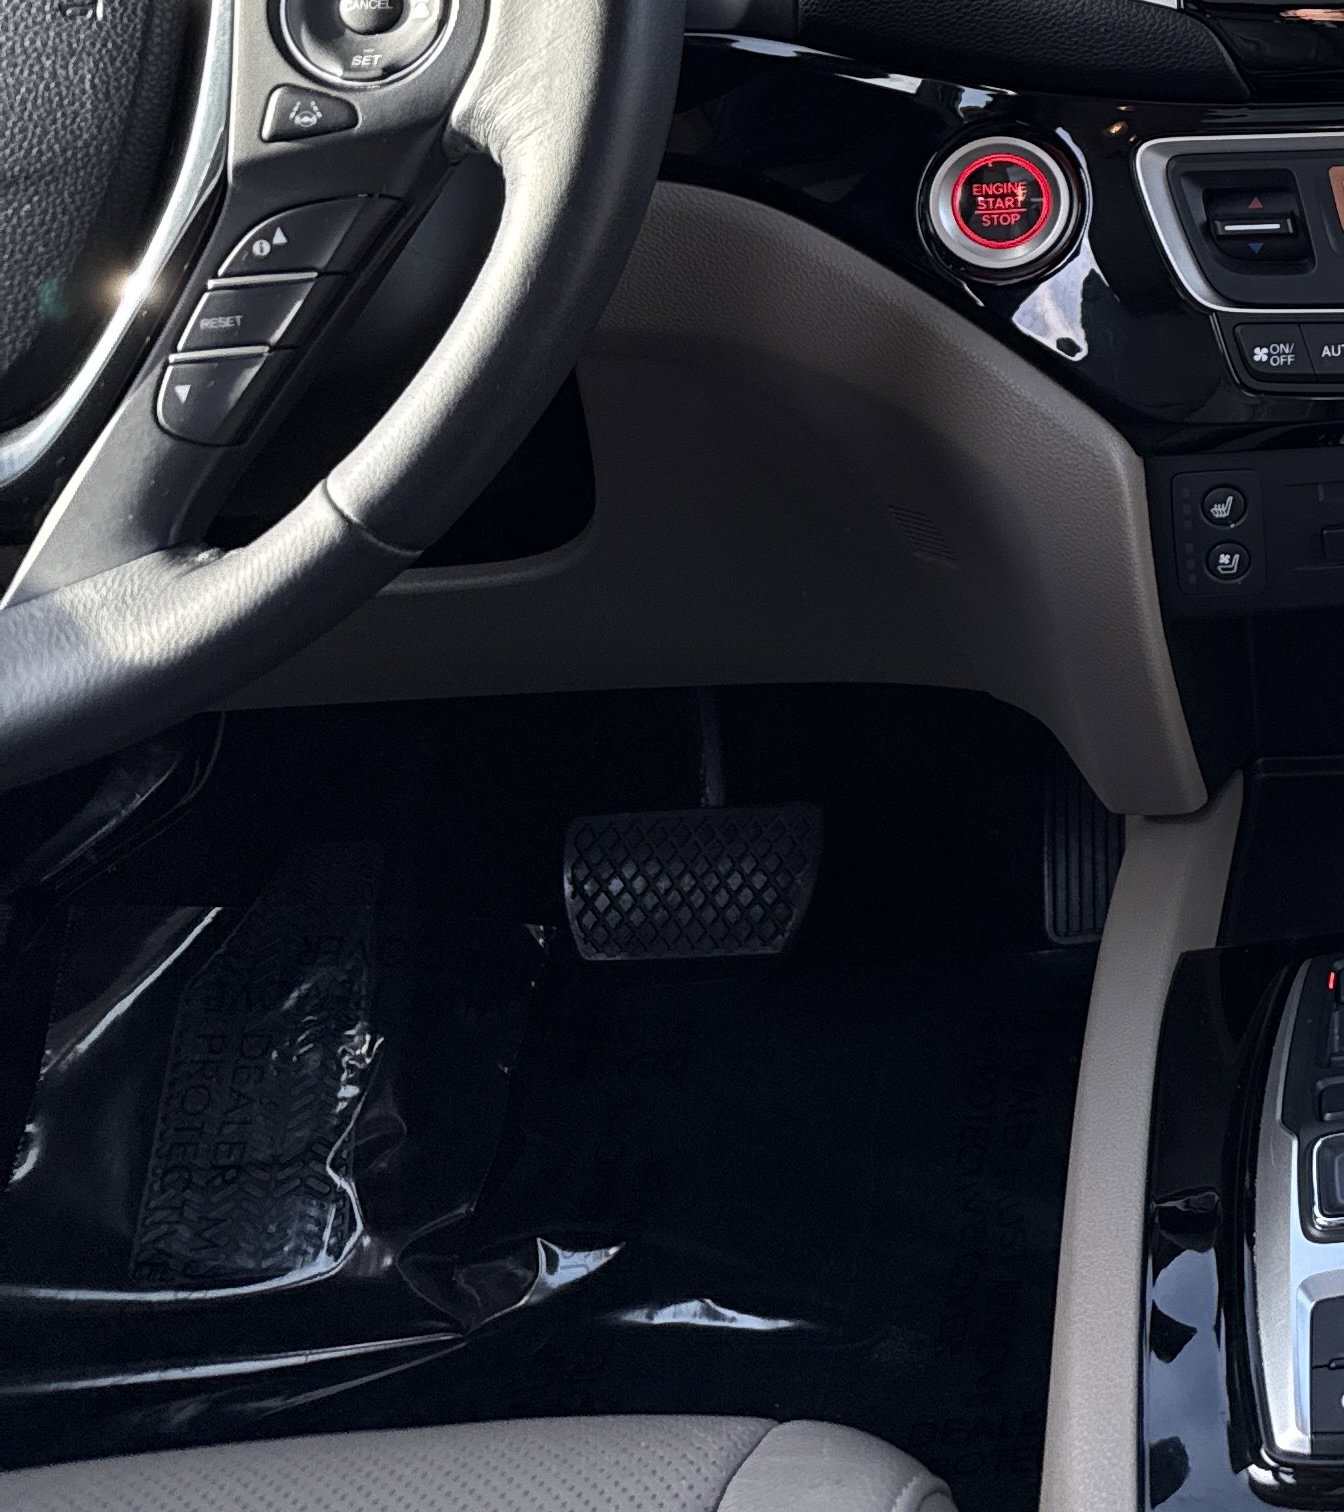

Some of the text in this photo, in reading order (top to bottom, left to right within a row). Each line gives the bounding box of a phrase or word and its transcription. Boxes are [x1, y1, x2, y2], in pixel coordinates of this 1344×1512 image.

[344, 0, 394, 11] CANCEL
[351, 54, 383, 66] SET
[971, 181, 1028, 196] ENGINE
[977, 196, 1022, 210] START
[981, 213, 1021, 227] STOP
[200, 315, 243, 330] RESET
[1269, 343, 1295, 355] ON/
[1269, 354, 1296, 367] OFF
